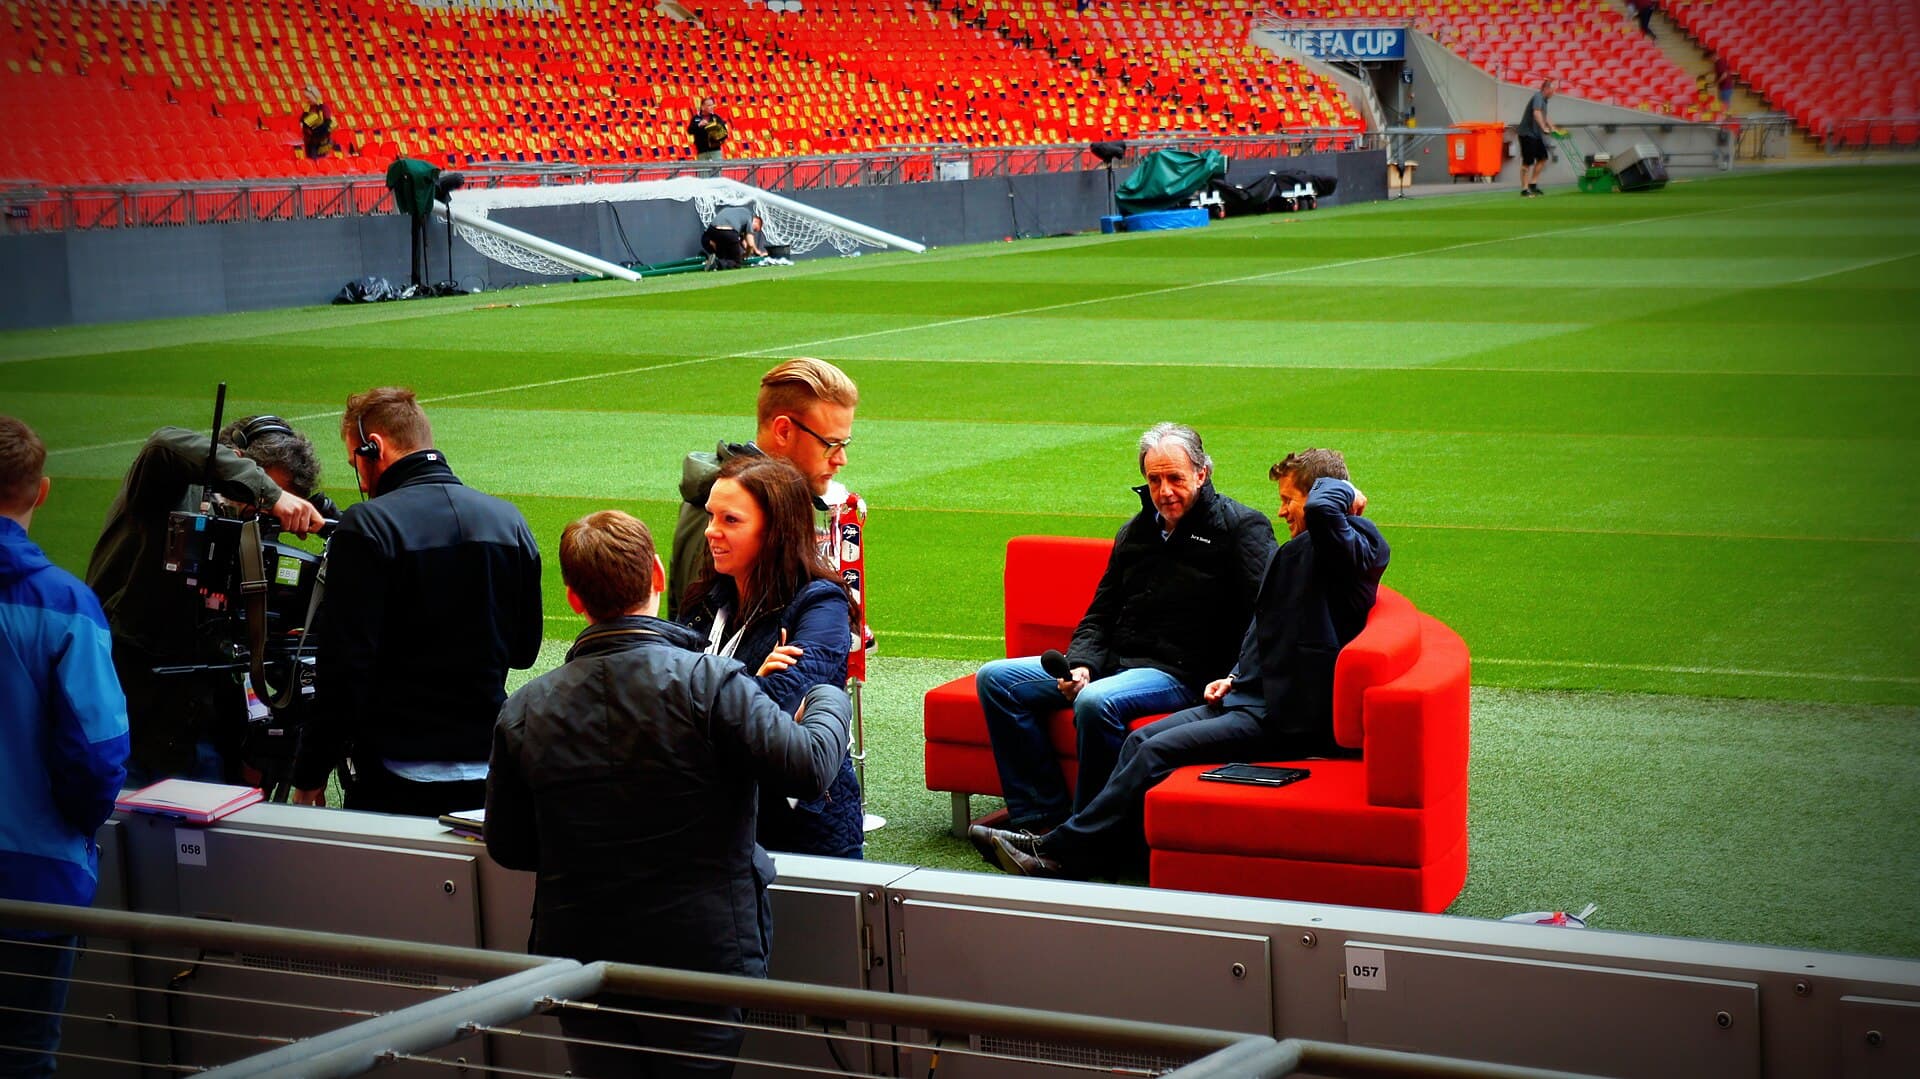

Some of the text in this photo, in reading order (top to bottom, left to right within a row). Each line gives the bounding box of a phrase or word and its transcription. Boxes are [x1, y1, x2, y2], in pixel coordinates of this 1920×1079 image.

[1319, 32, 1349, 56] FA
[1352, 31, 1397, 56] CUP
[181, 843, 201, 855] 058
[1352, 965, 1379, 978] 057
